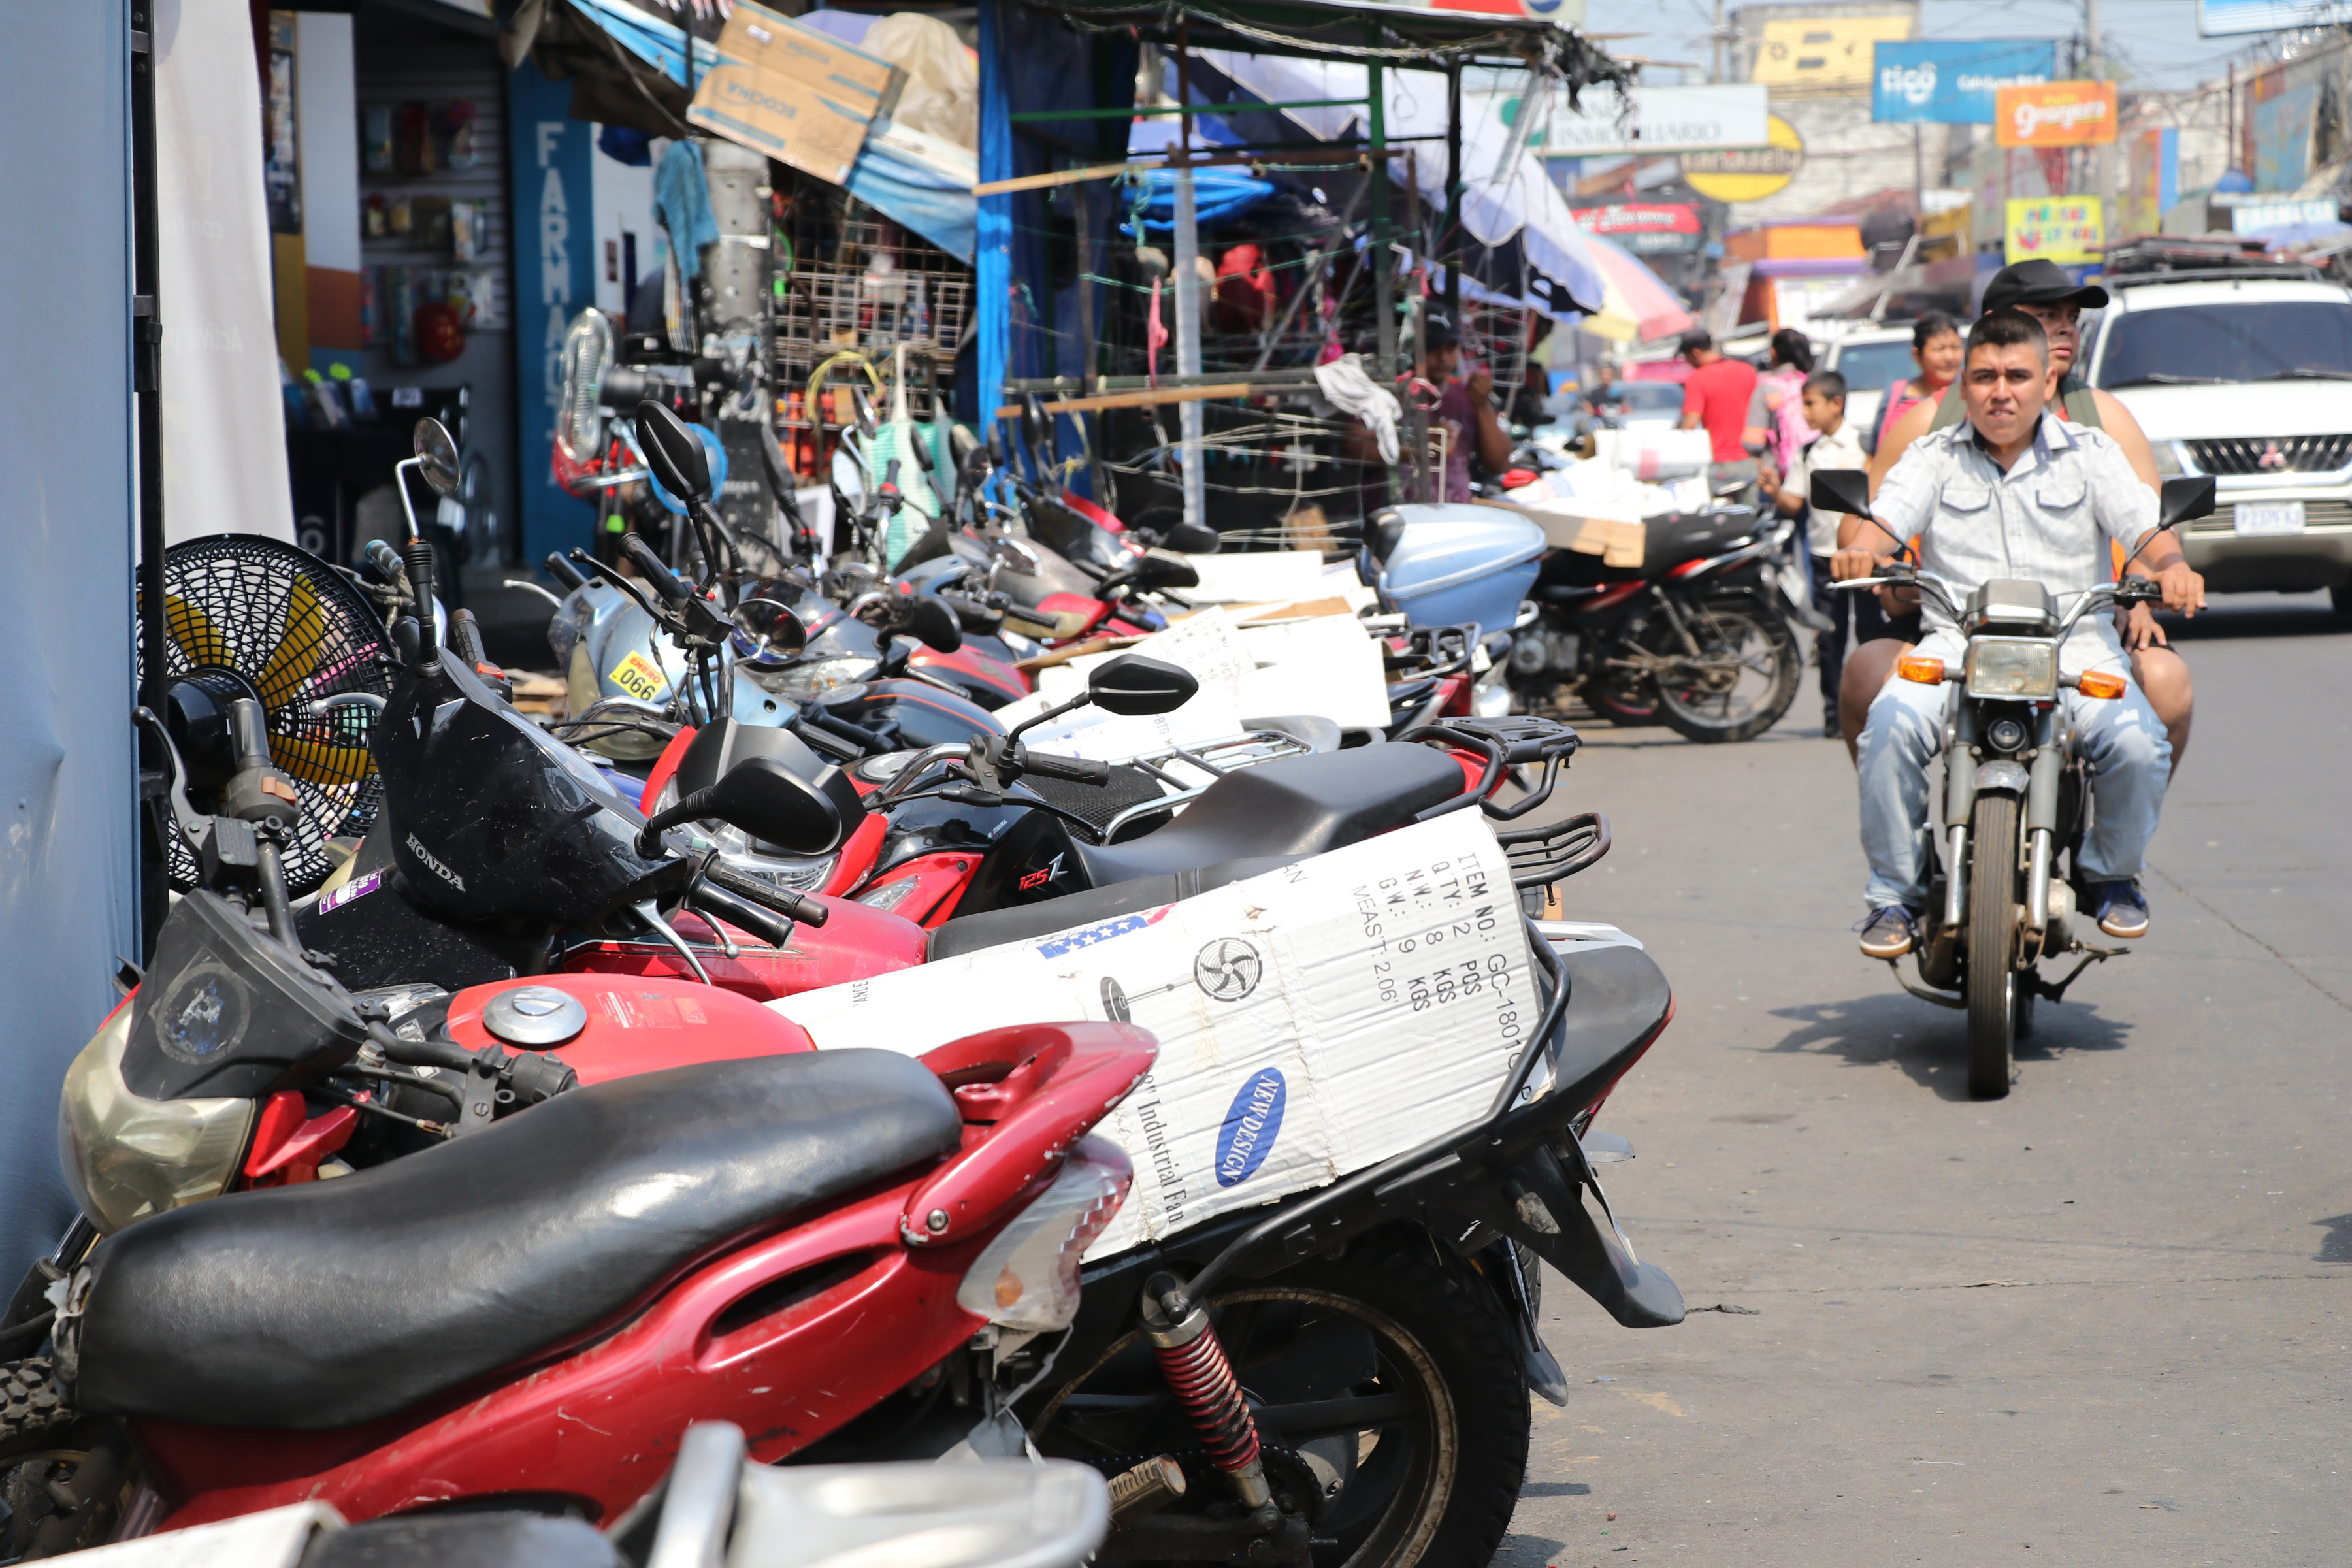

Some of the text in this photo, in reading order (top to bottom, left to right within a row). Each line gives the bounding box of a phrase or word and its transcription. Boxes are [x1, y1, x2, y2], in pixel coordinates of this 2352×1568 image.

[725, 80, 797, 119] ECOCINA
[1881, 61, 1937, 104] tigo
[619, 668, 656, 701] 066
[629, 656, 662, 684] ENERO
[406, 832, 466, 892] HONDA
[1457, 852, 1489, 898] ITEM
[1474, 905, 1496, 942] NO.:
[1426, 930, 1443, 945] 8
[1431, 860, 1482, 995] Q'TY: 2 PCS
[1398, 939, 1416, 953] 9
[1407, 976, 1431, 1012] KGS
[1433, 968, 1456, 1004] KGS
[1220, 1074, 1281, 1181] NEW DESIGN
[1137, 1098, 1183, 1189] Industrial
[1163, 1187, 1188, 1224] Fan
